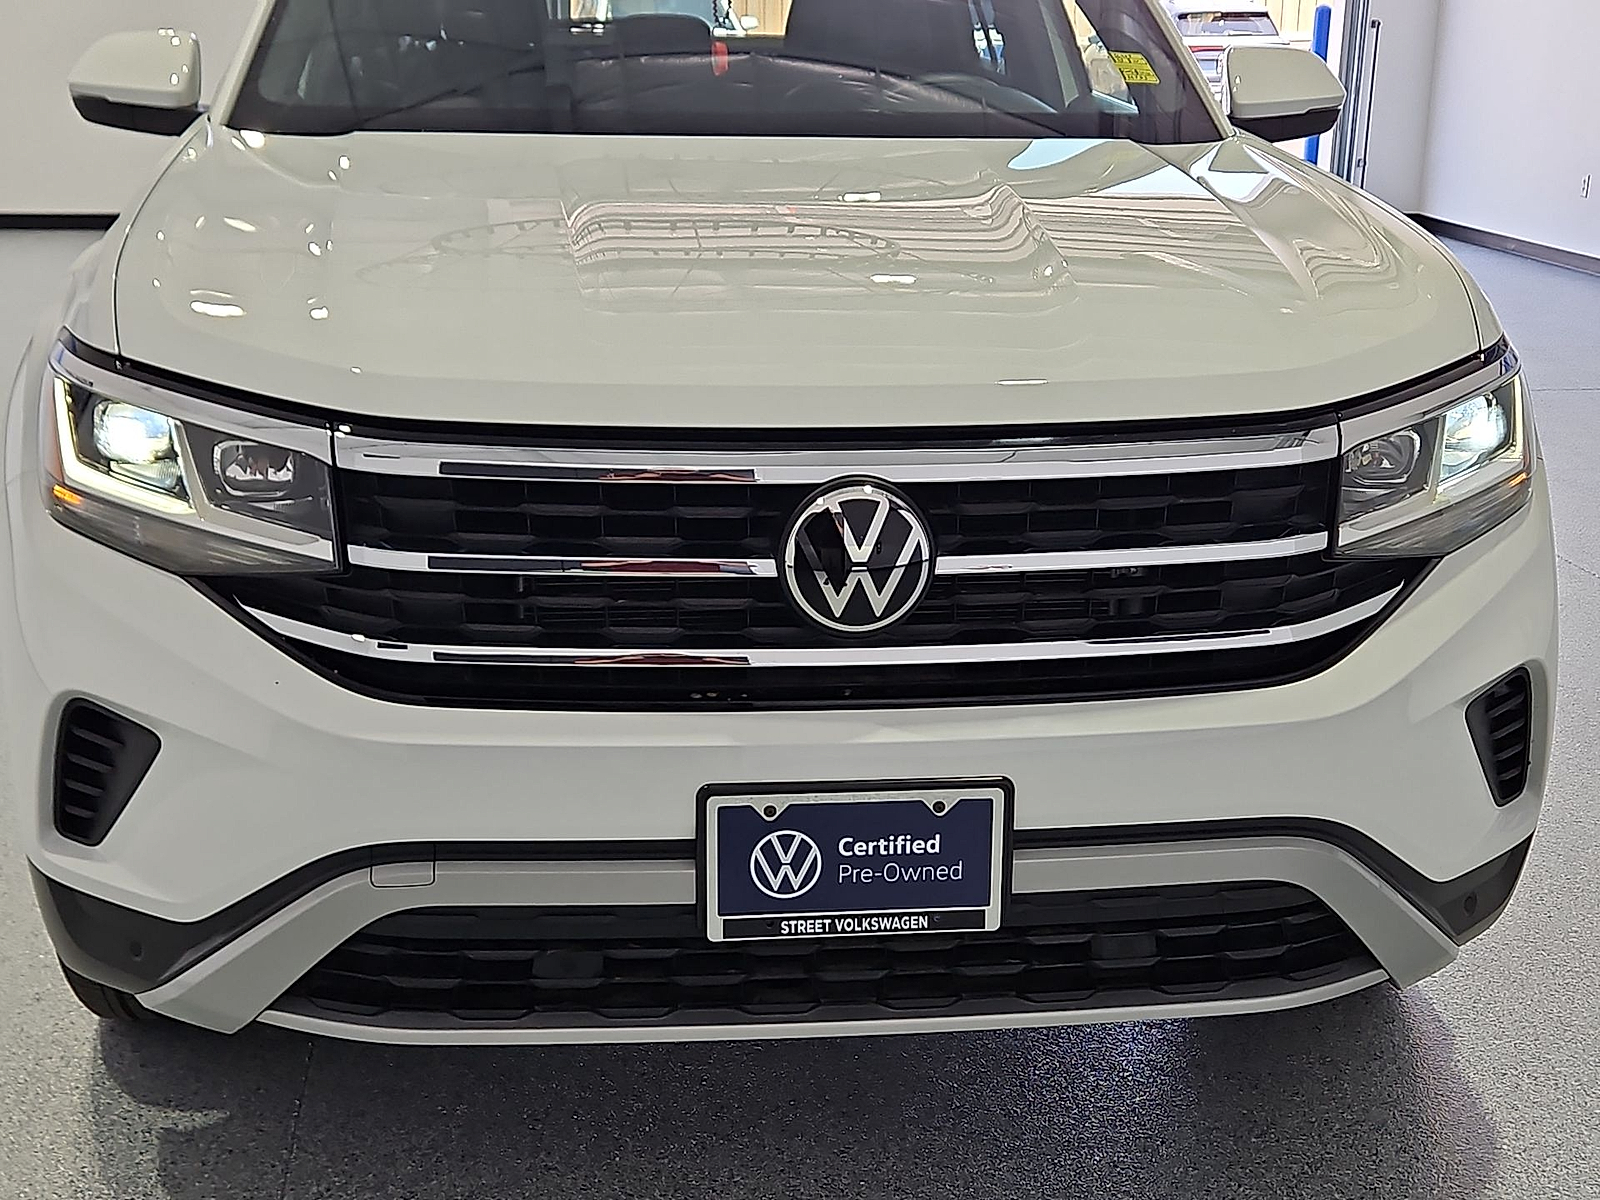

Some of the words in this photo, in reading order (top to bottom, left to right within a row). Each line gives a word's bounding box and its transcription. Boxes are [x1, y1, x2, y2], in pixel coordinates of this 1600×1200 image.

[838, 834, 941, 857] Certified
[838, 860, 963, 884] Pre-Owned
[780, 918, 831, 934] STREET
[835, 915, 929, 932] VOLKSWAGEN
